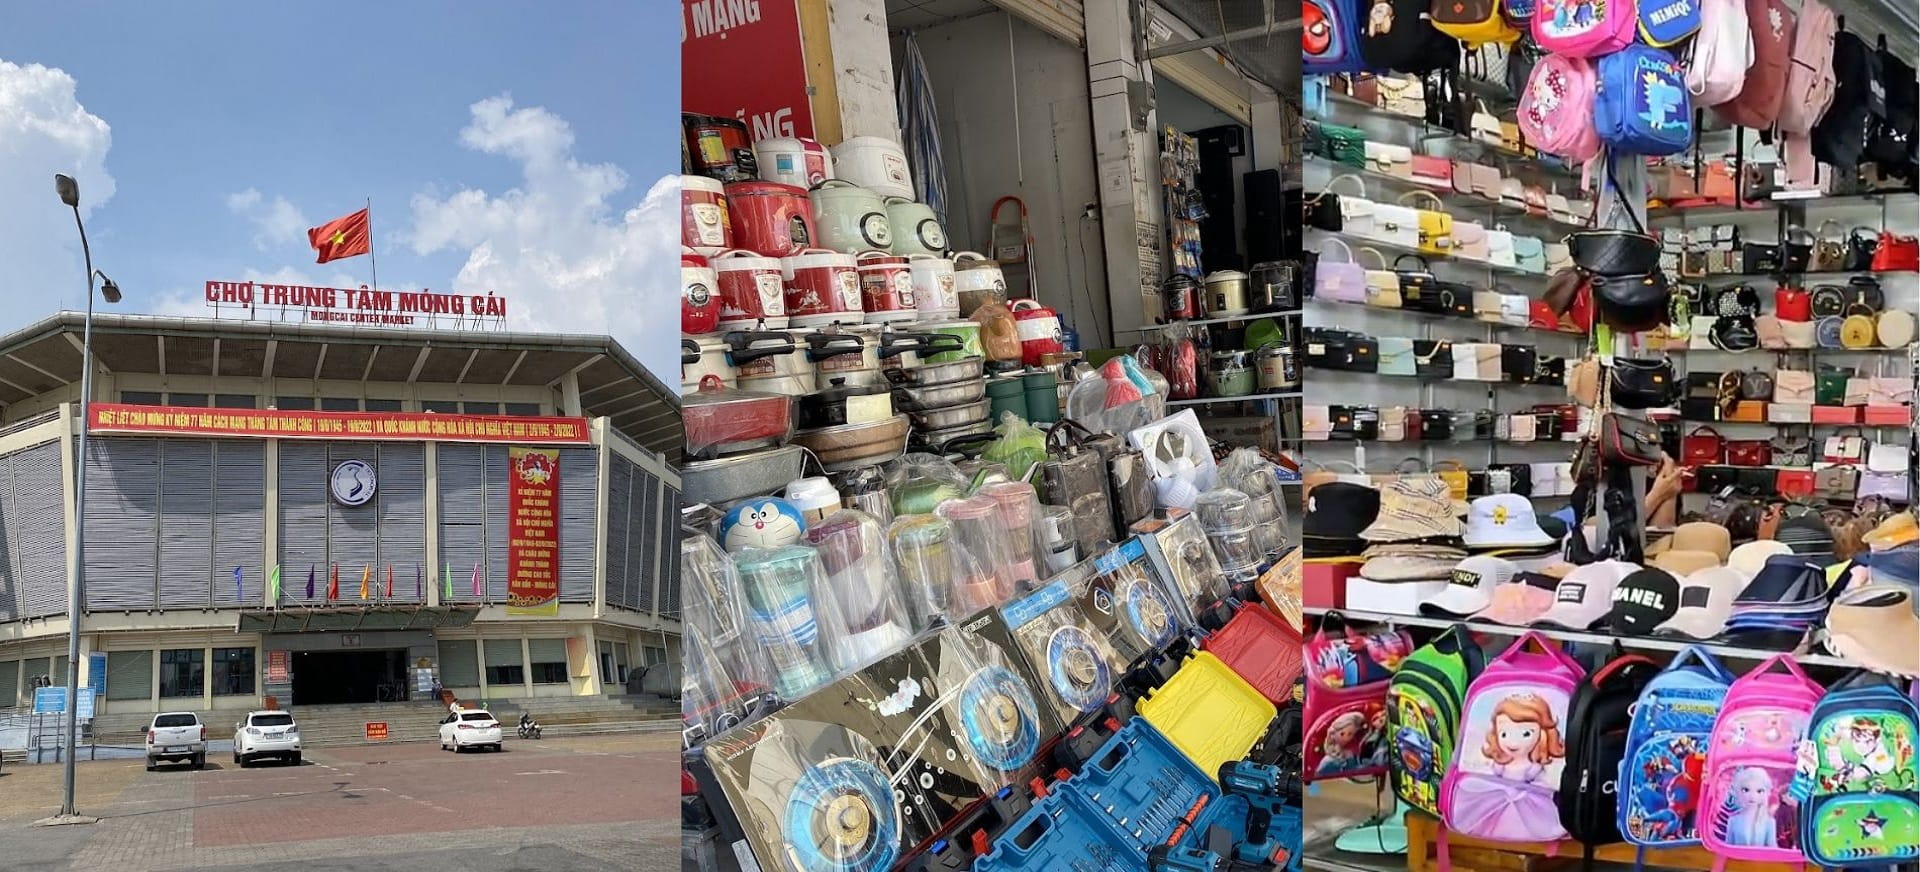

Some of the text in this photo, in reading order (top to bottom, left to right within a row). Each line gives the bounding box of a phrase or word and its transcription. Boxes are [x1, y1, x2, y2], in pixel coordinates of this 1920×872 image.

[692, 0, 761, 39] MẠNG
[206, 281, 506, 316] CHỢ TRUNG TÂM MÓNG CÁI
[310, 311, 414, 325] MONGCAI CENTER MARKET
